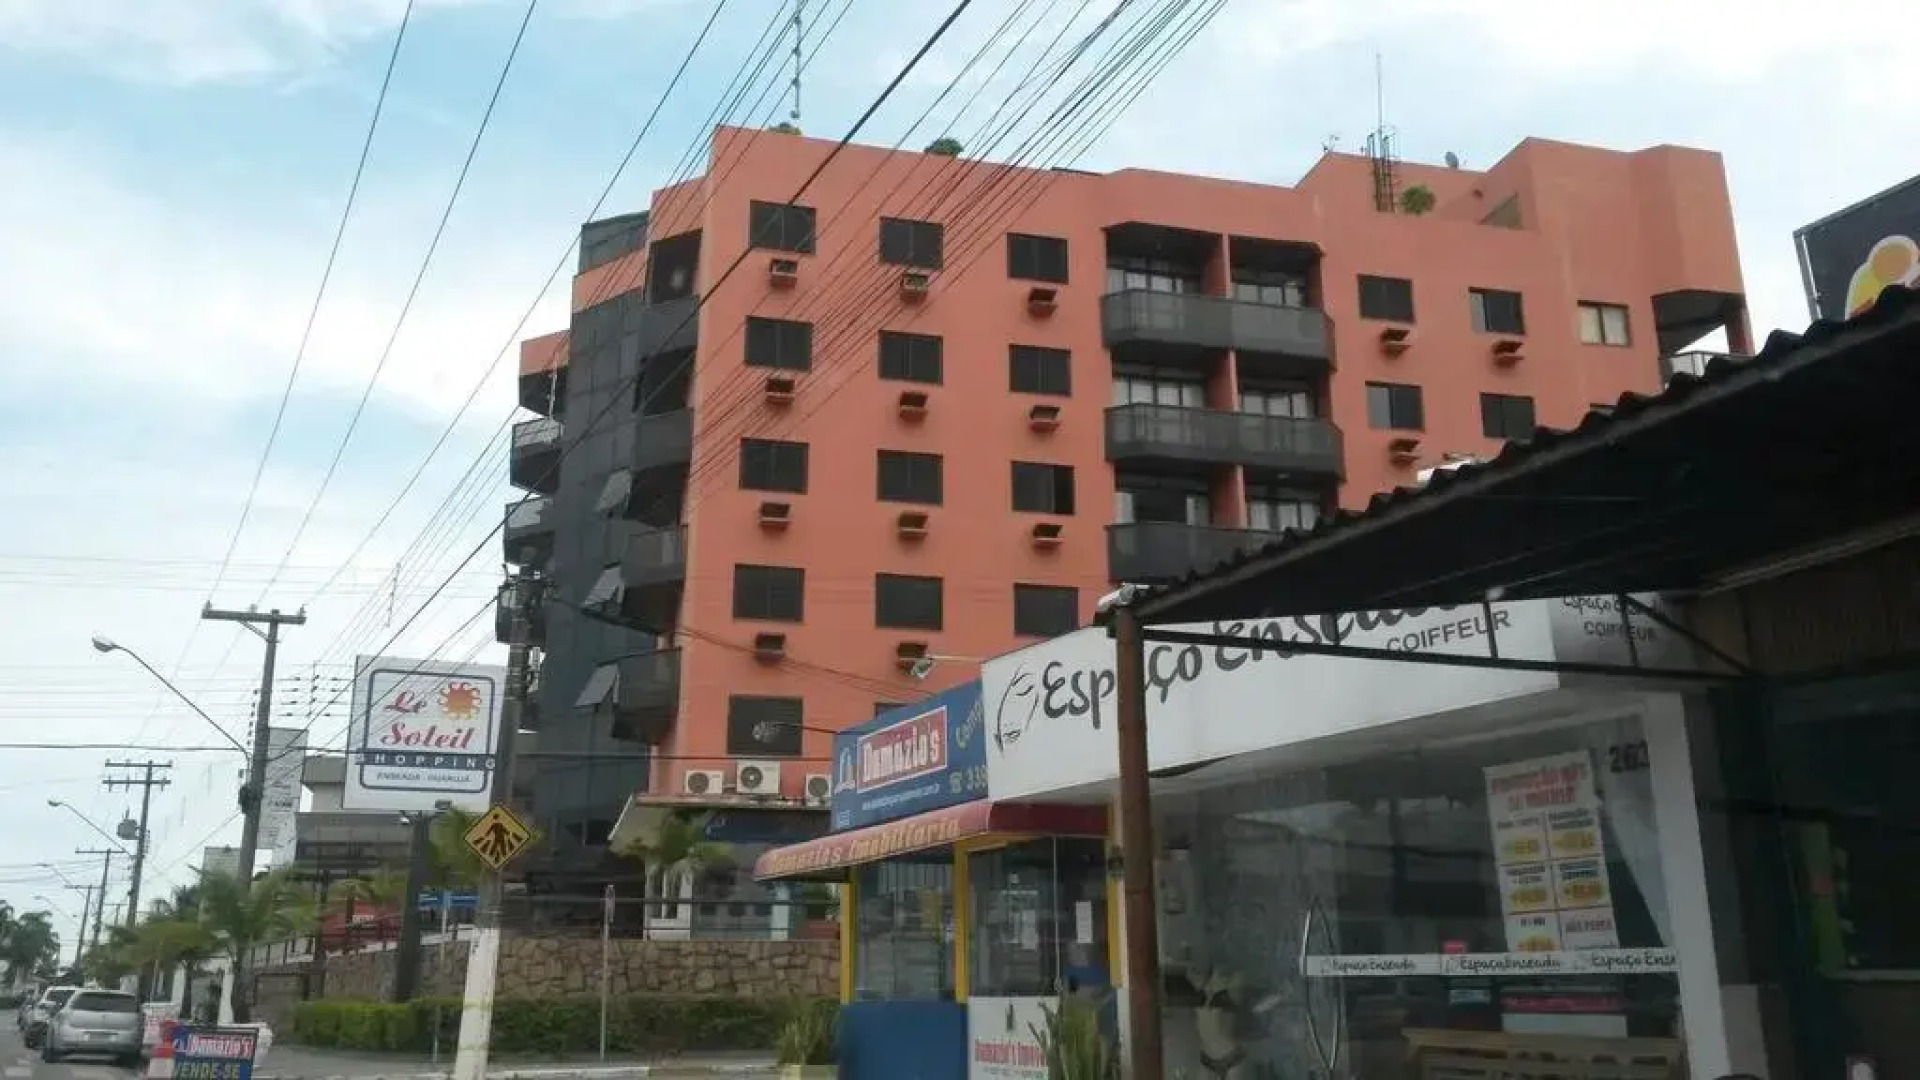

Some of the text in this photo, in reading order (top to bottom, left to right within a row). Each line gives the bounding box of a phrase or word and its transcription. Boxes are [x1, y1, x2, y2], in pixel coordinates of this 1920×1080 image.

[1042, 645, 1203, 730] Espço
[380, 722, 475, 749] Soleil
[355, 752, 496, 770] SHOPPING
